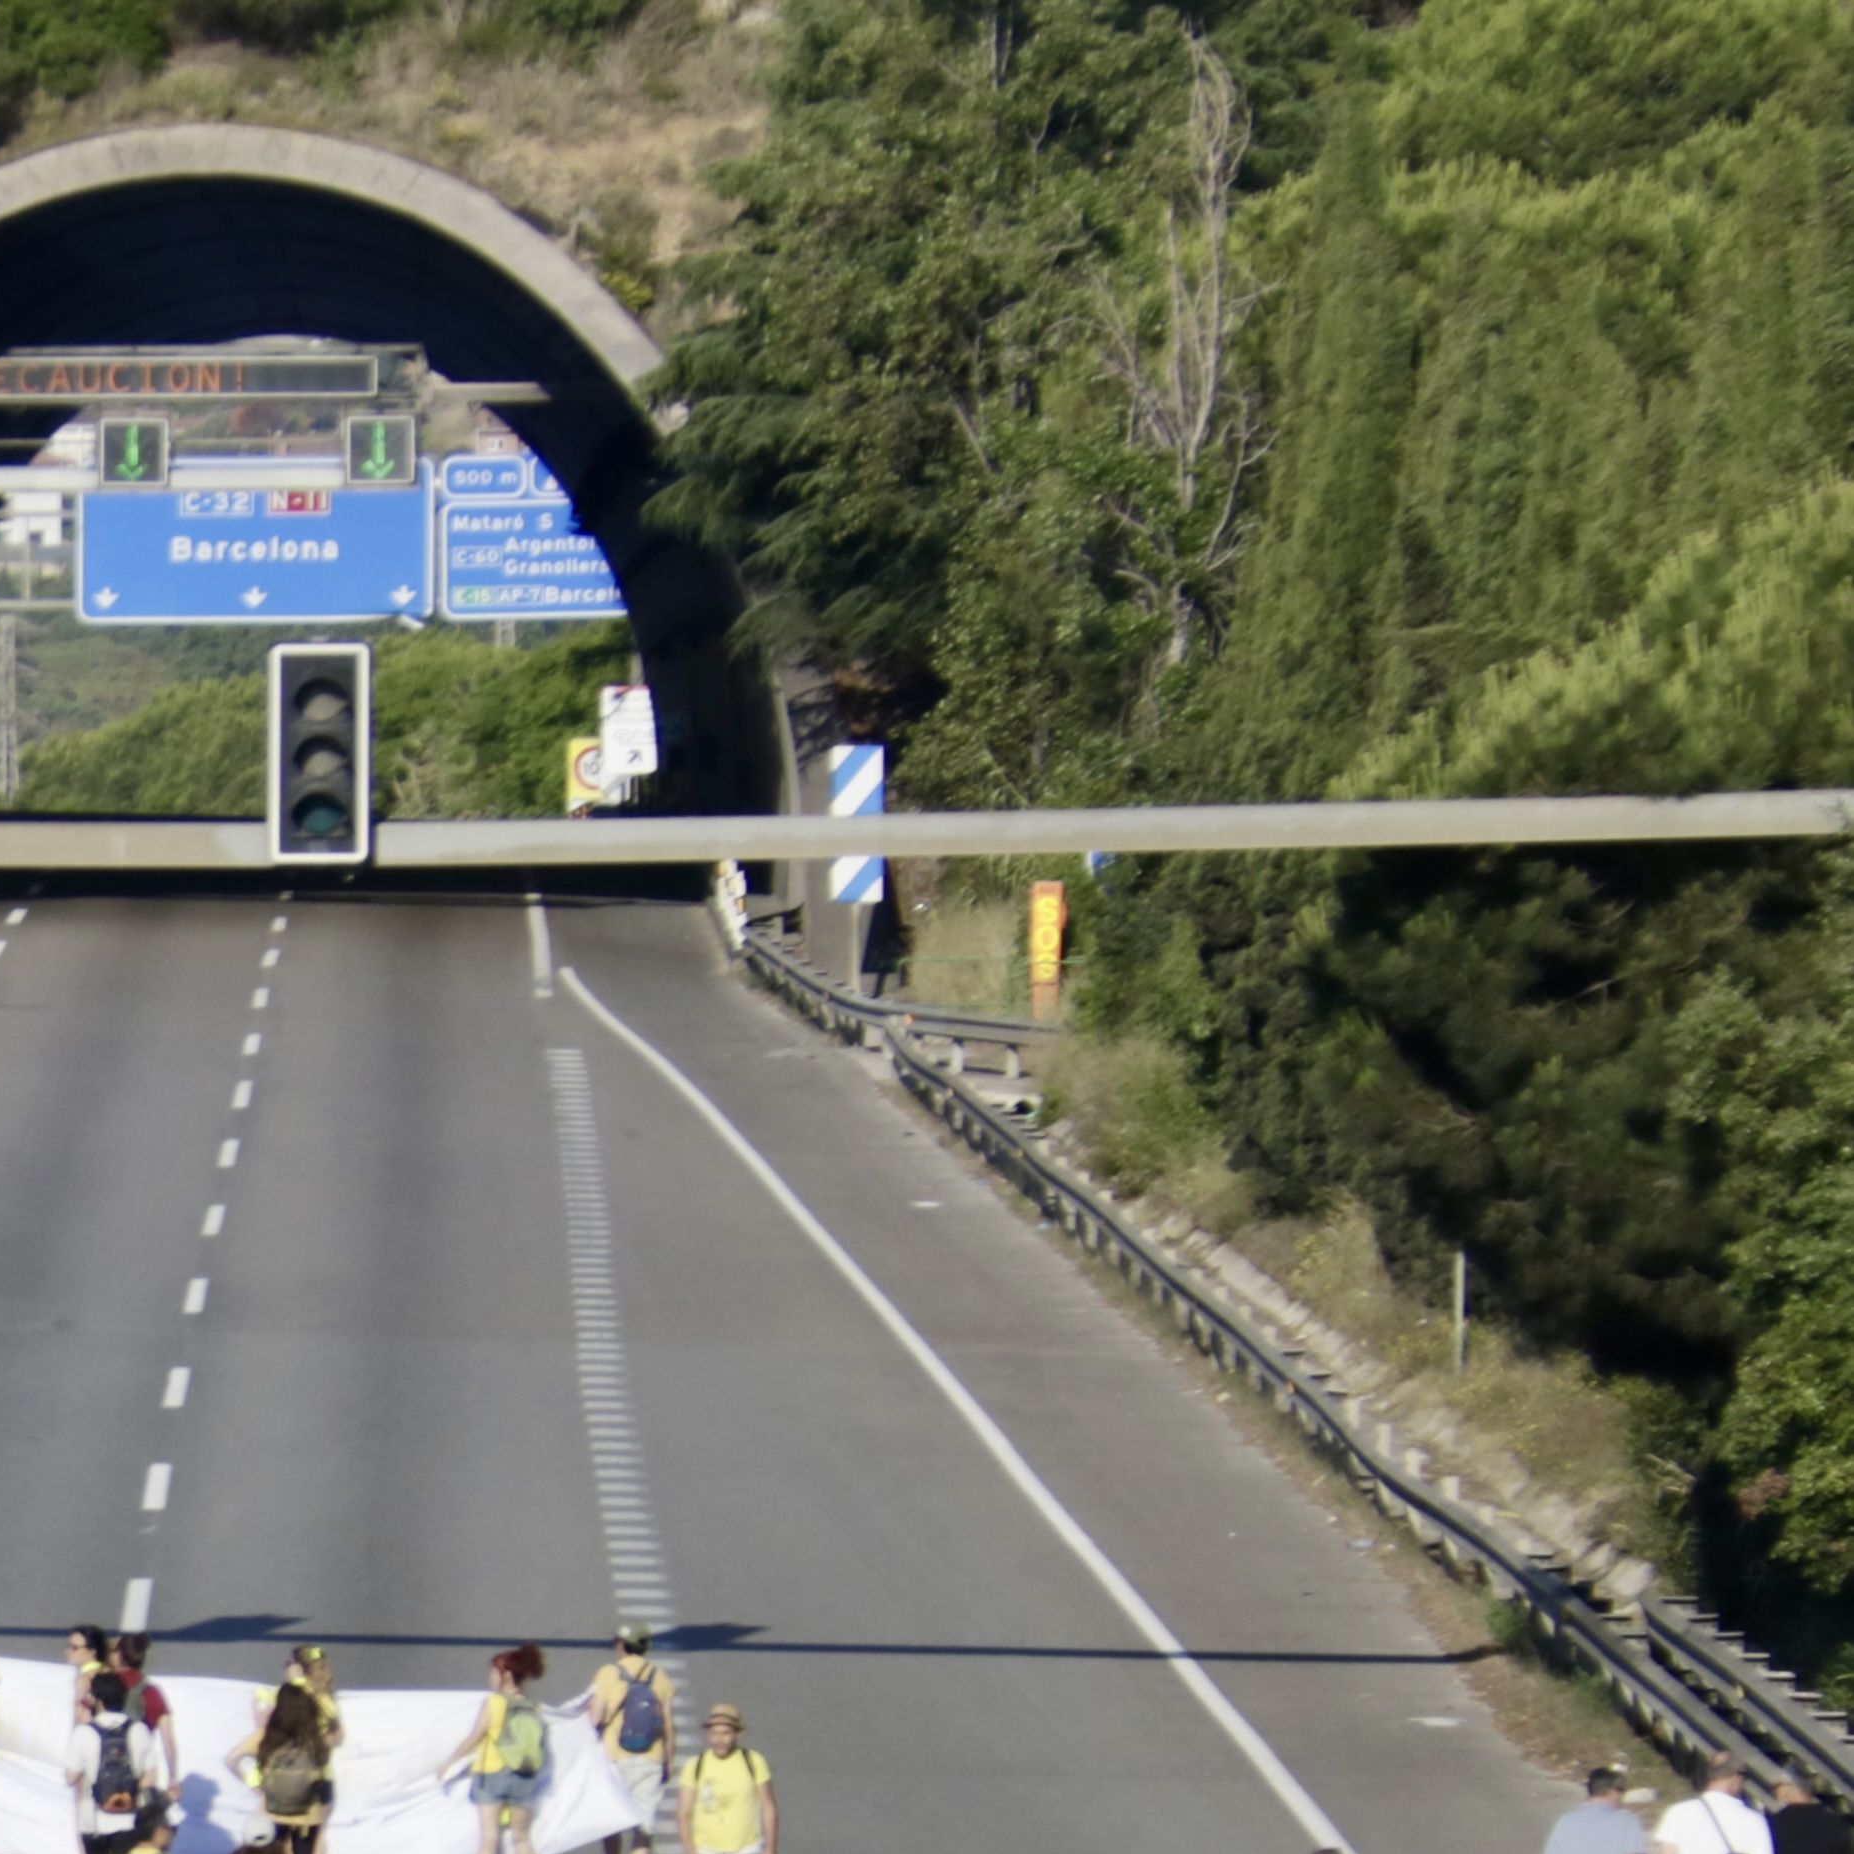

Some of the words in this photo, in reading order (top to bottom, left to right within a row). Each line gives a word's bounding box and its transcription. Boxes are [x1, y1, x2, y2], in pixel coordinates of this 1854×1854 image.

[455, 469, 493, 485] 500
[500, 471, 518, 485] m
[184, 491, 250, 512] C-32
[452, 512, 524, 532] Mataró
[169, 534, 340, 562] Barcelona
[1033, 896, 1059, 981] SOS
